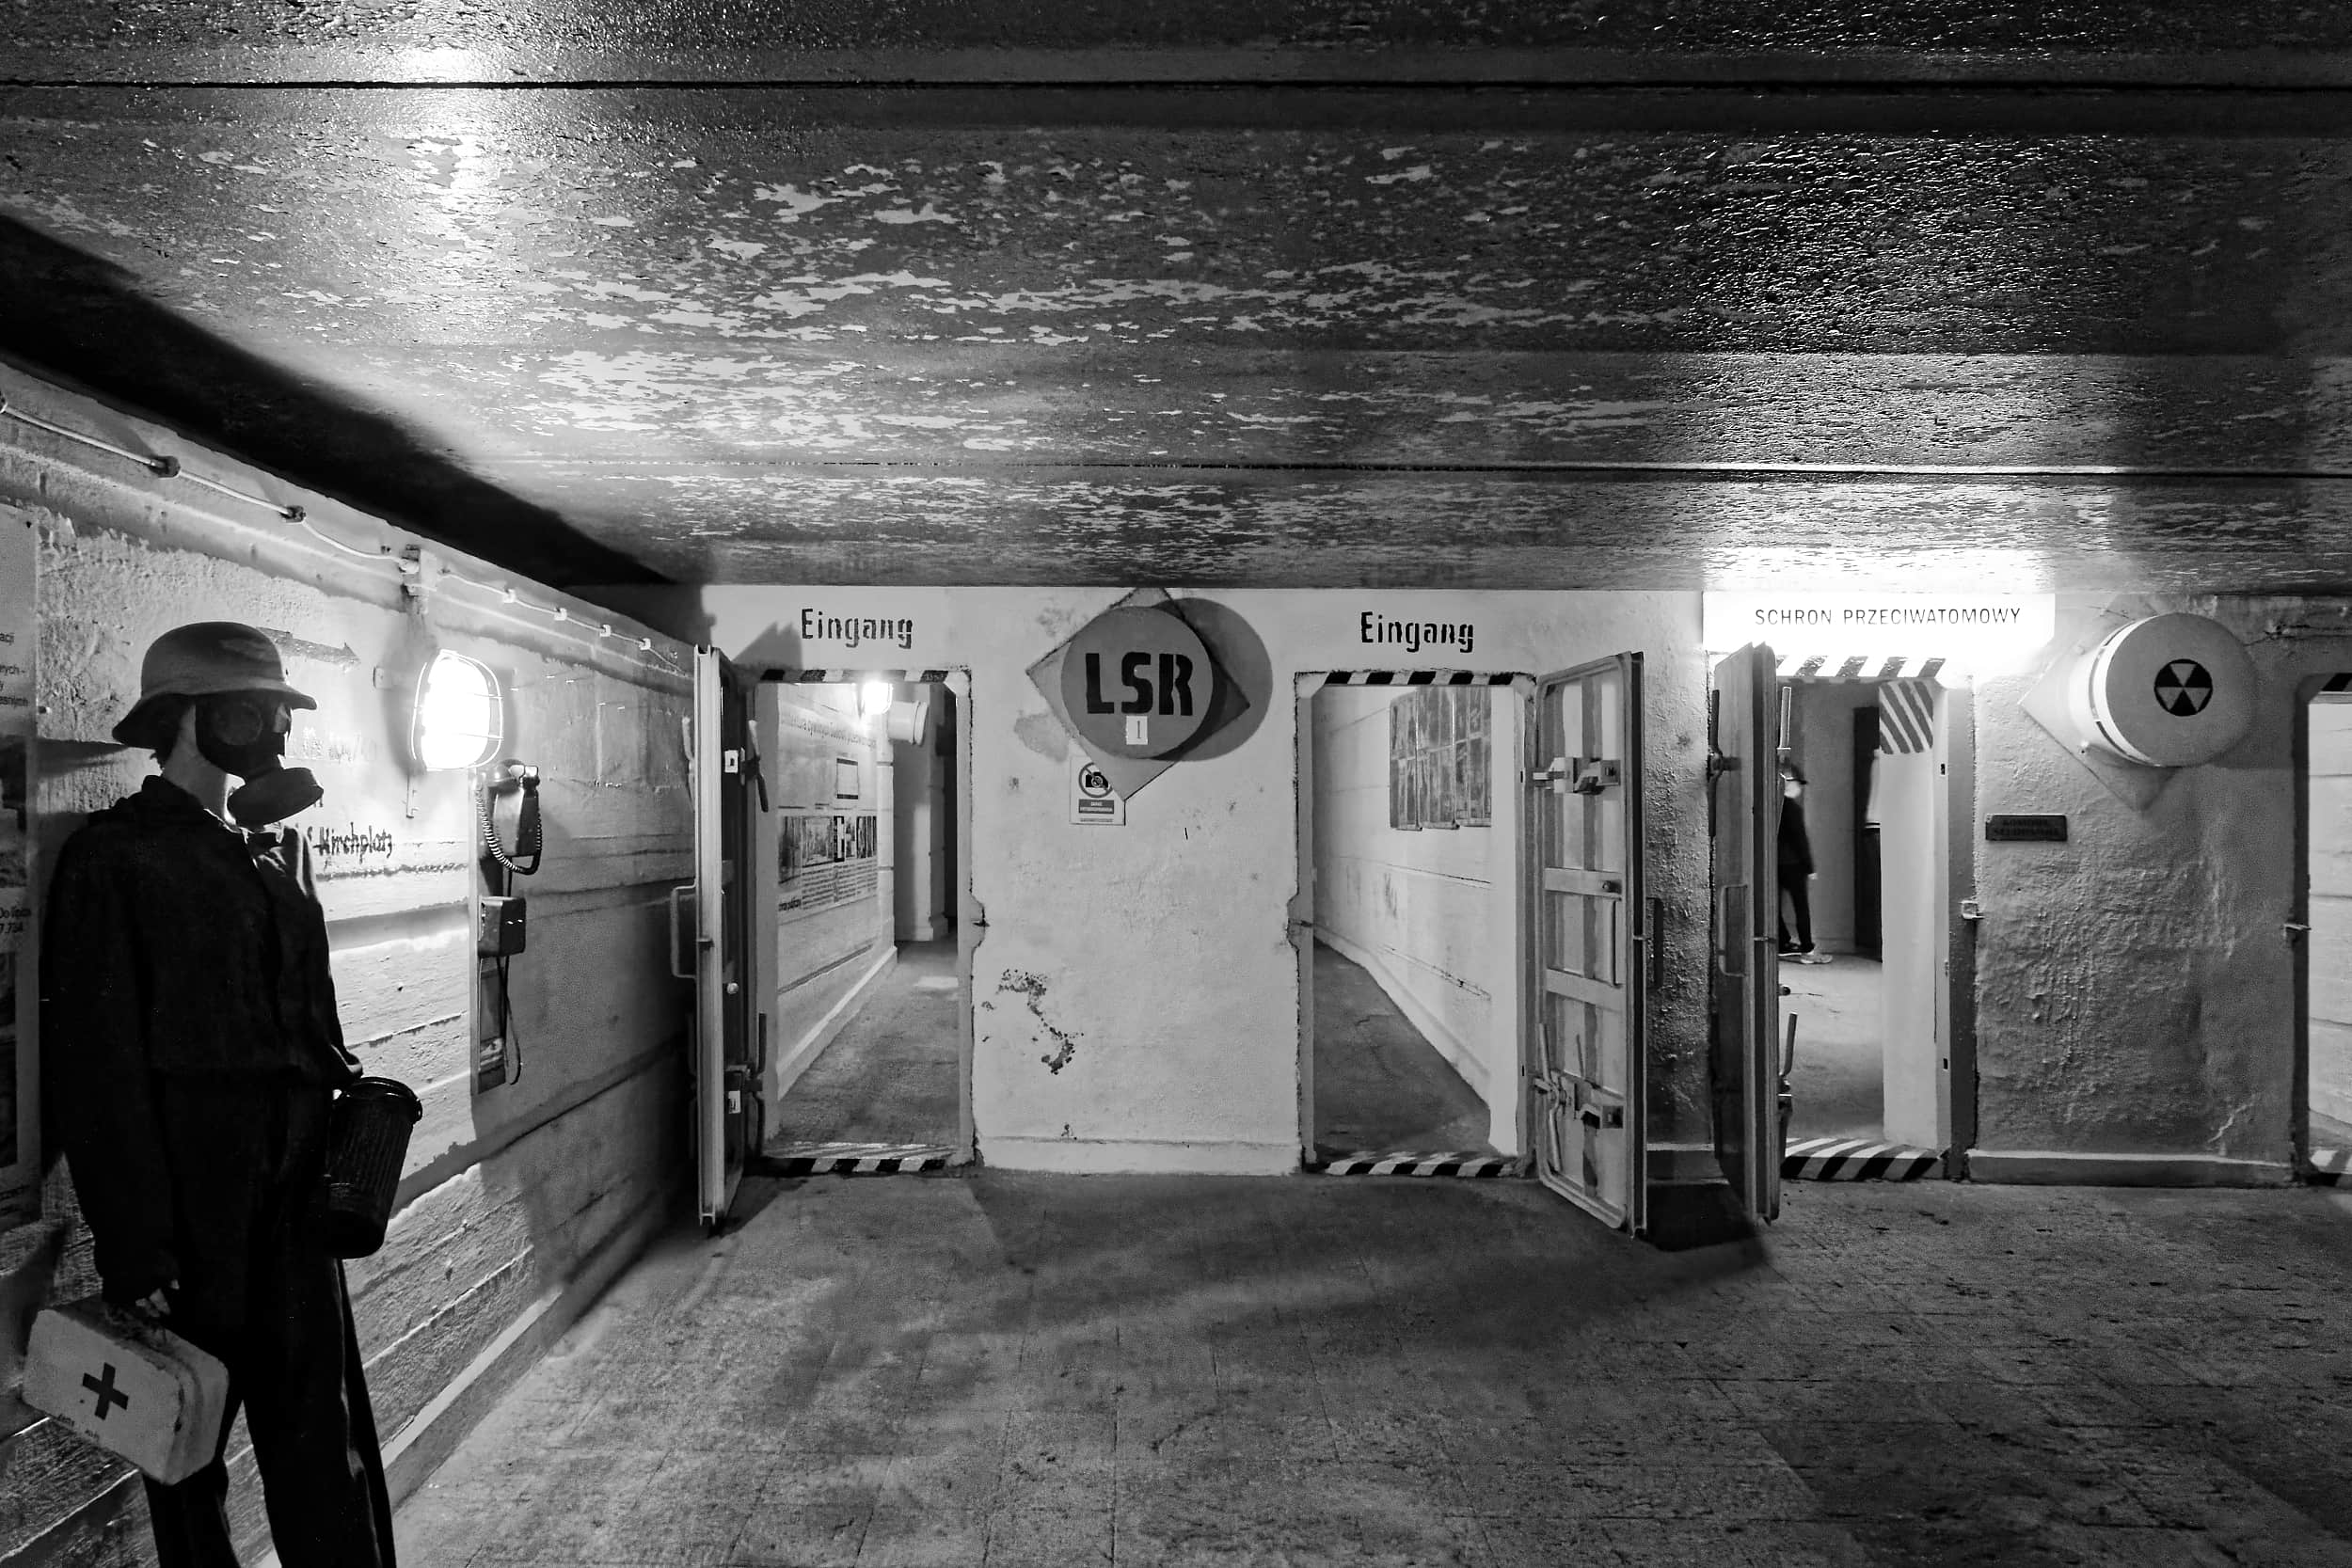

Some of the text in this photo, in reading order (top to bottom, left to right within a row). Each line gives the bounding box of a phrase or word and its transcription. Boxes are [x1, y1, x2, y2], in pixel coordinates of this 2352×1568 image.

[802, 609, 913, 649] Eingang
[1360, 611, 1473, 653] Eingang
[1755, 608, 2020, 626] SCHRON PRZECIWATOMOWY
[1085, 652, 1193, 716] LSR
